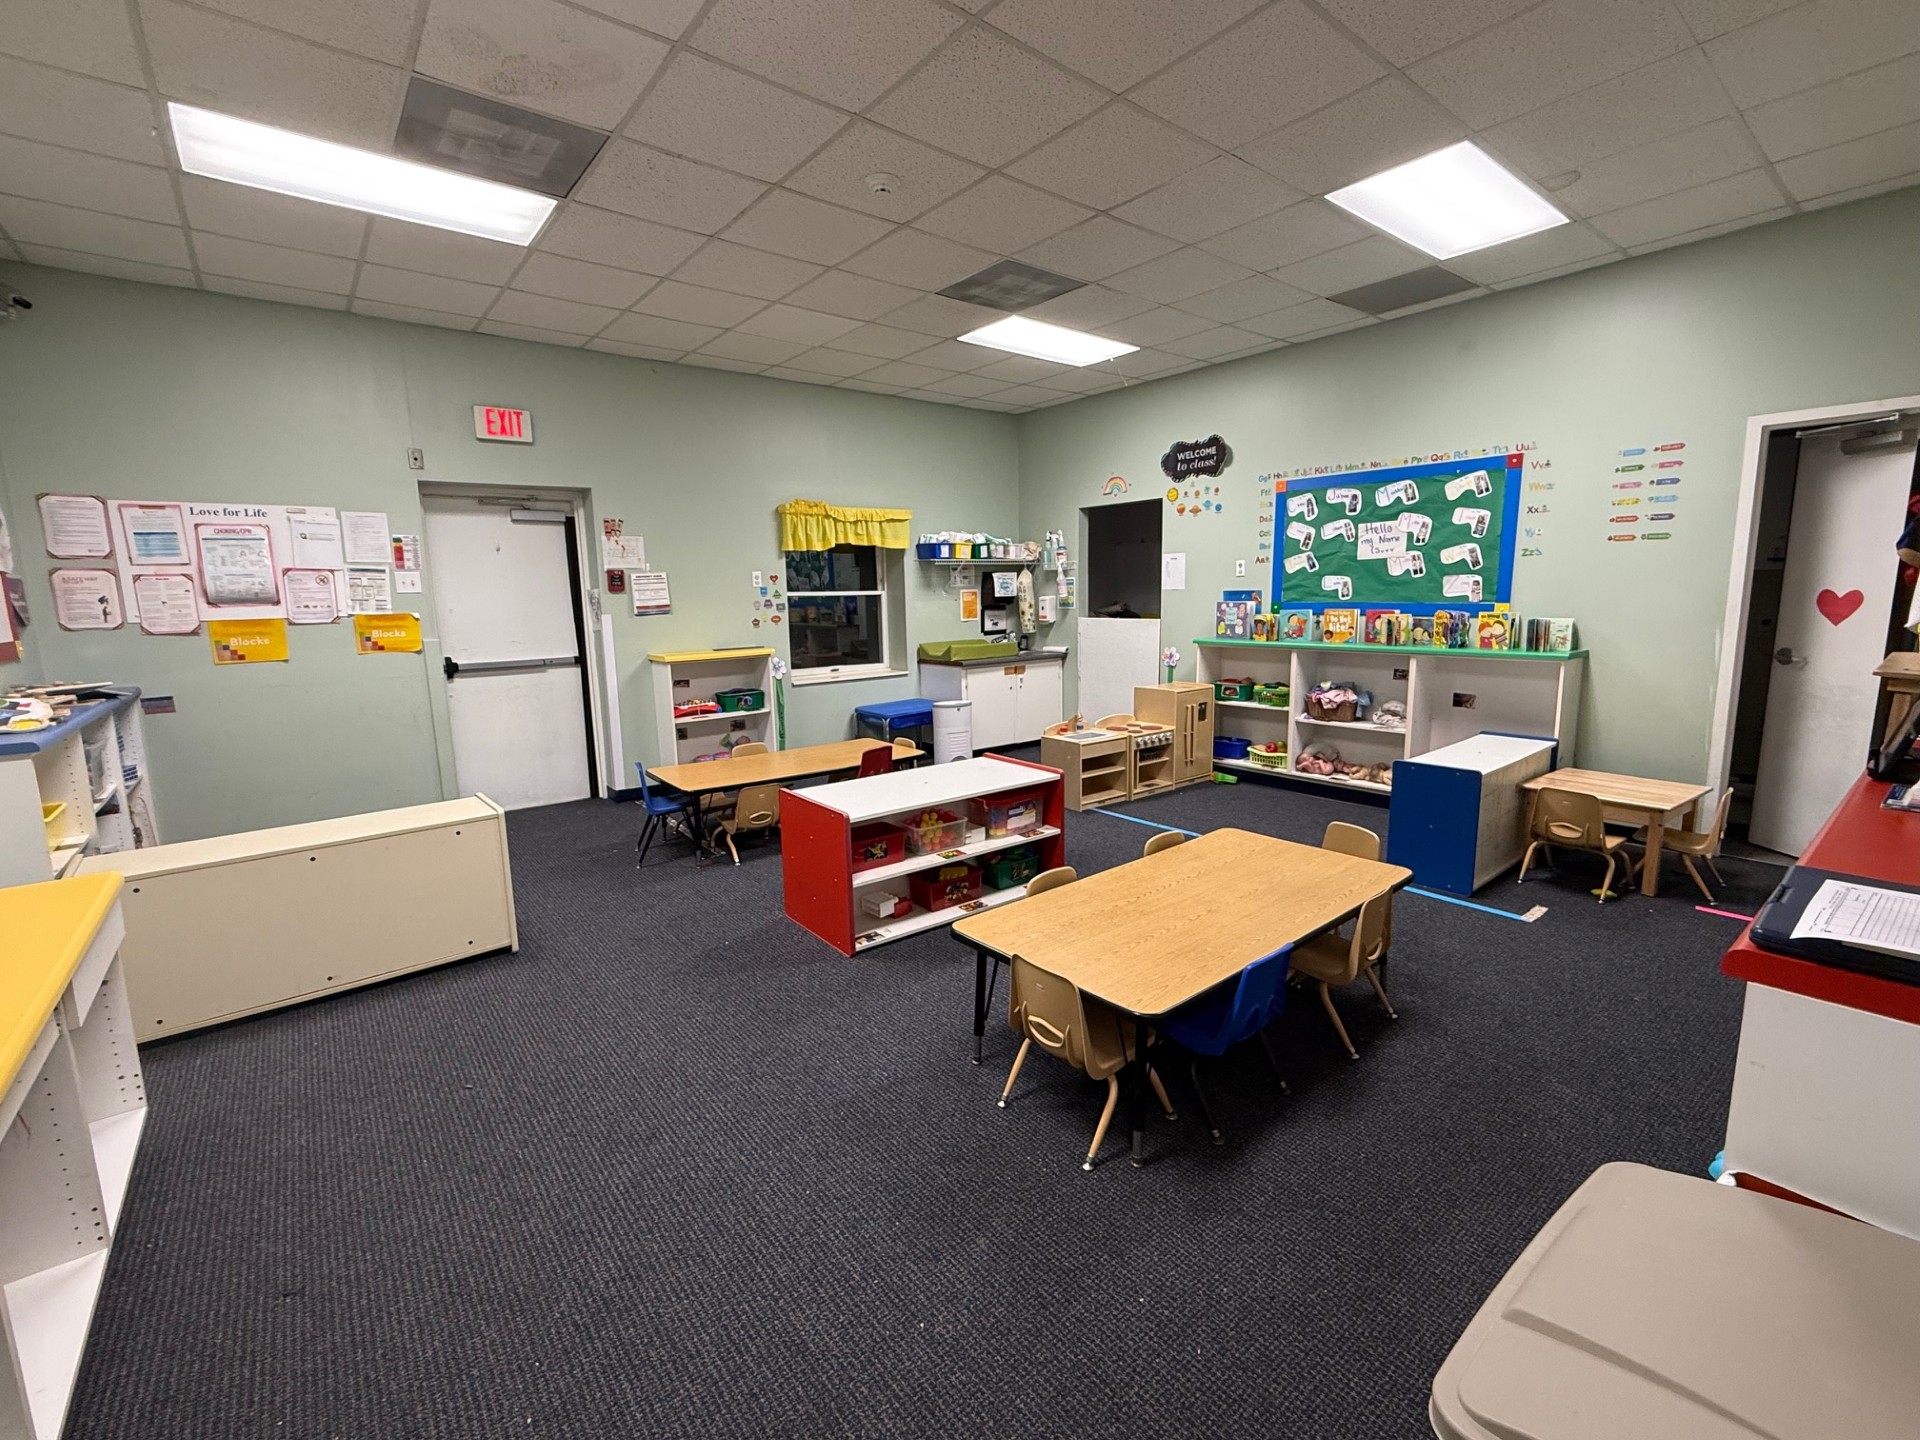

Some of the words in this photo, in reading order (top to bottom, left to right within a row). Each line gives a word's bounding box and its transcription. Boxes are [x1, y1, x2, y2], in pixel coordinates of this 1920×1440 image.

[485, 408, 523, 438] EXIT
[1176, 446, 1217, 461] WELCOME
[1370, 461, 1382, 470] Nn
[1410, 456, 1423, 465] Pp
[1430, 453, 1444, 462] Qq
[1515, 442, 1530, 452] Uu
[1177, 462, 1188, 472] to
[1189, 456, 1217, 470] class!
[1530, 461, 1544, 470] Vv
[189, 506, 220, 517] Love
[223, 507, 241, 517] for
[243, 508, 268, 518] Life
[1526, 505, 1539, 514] Xx
[1365, 523, 1393, 535] Hello
[1360, 537, 1374, 547] my
[1378, 535, 1401, 545] Name
[1521, 548, 1534, 557] Zz
[371, 629, 407, 639] Blocks
[229, 636, 270, 647] Blocks
